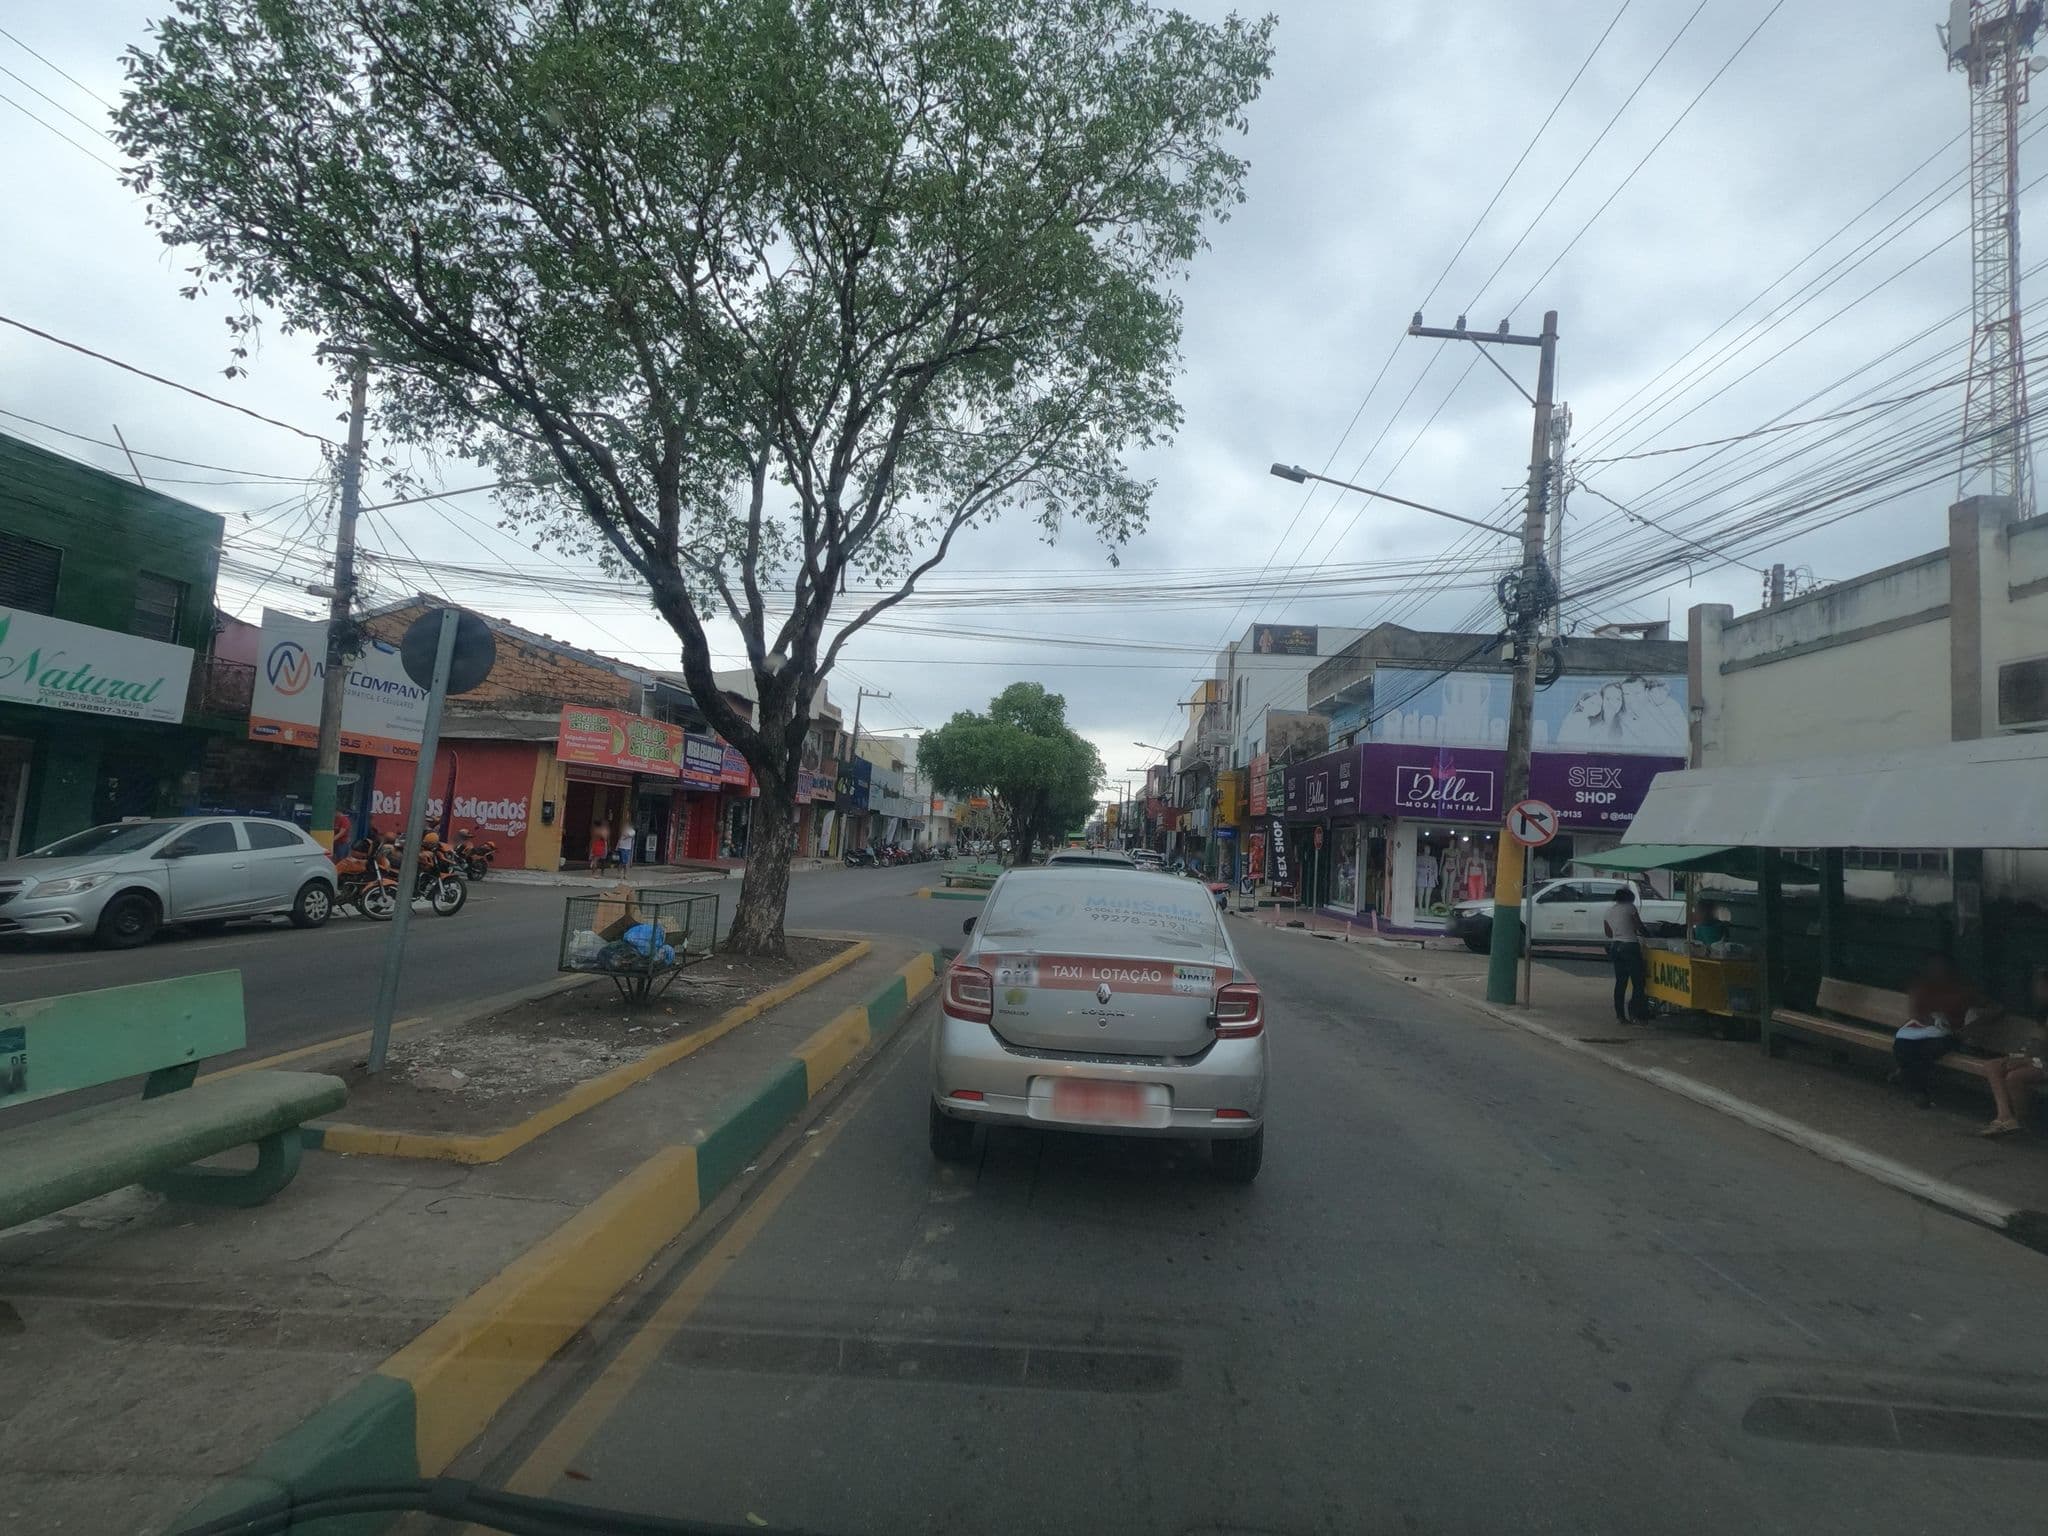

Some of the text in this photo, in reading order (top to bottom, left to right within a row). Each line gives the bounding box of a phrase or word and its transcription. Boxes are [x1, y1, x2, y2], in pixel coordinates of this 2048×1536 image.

[0, 648, 165, 704] Natural
[340, 737, 361, 749] SUS
[1408, 773, 1480, 803] Della
[1568, 766, 1622, 789] SEX
[371, 790, 402, 815] Rei
[453, 796, 527, 825] Salgados
[1405, 801, 1437, 809] MODA
[1575, 791, 1617, 805] SHOP
[1556, 809, 1583, 818] 2-0135
[1273, 820, 1288, 878] SEX SHOP
[1051, 964, 1083, 978] TAXI
[1091, 966, 1163, 984] LOTAÇÃO
[1653, 961, 1690, 993] LANCHE
